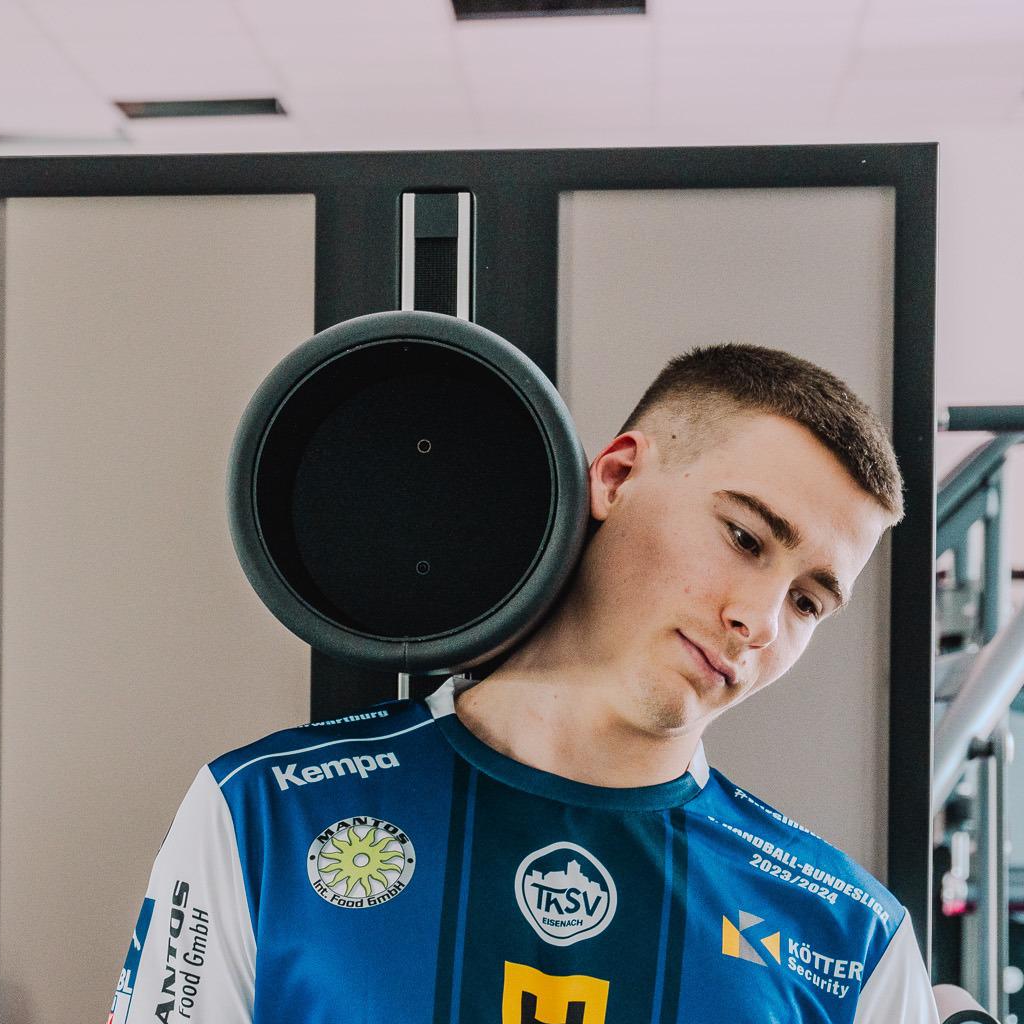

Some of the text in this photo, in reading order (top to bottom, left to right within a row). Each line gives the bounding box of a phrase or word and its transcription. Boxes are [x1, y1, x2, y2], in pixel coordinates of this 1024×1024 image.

[271, 751, 400, 791] Kempa
[317, 816, 409, 845] MANTOS
[312, 879, 406, 908] Int. Food GmbH
[749, 853, 839, 905] 2023/2024
[530, 882, 602, 917] TKSV
[182, 907, 209, 967] GmbH
[542, 917, 583, 927] EISENACH
[787, 956, 850, 999] Security
[788, 937, 864, 982] KÖTTER
